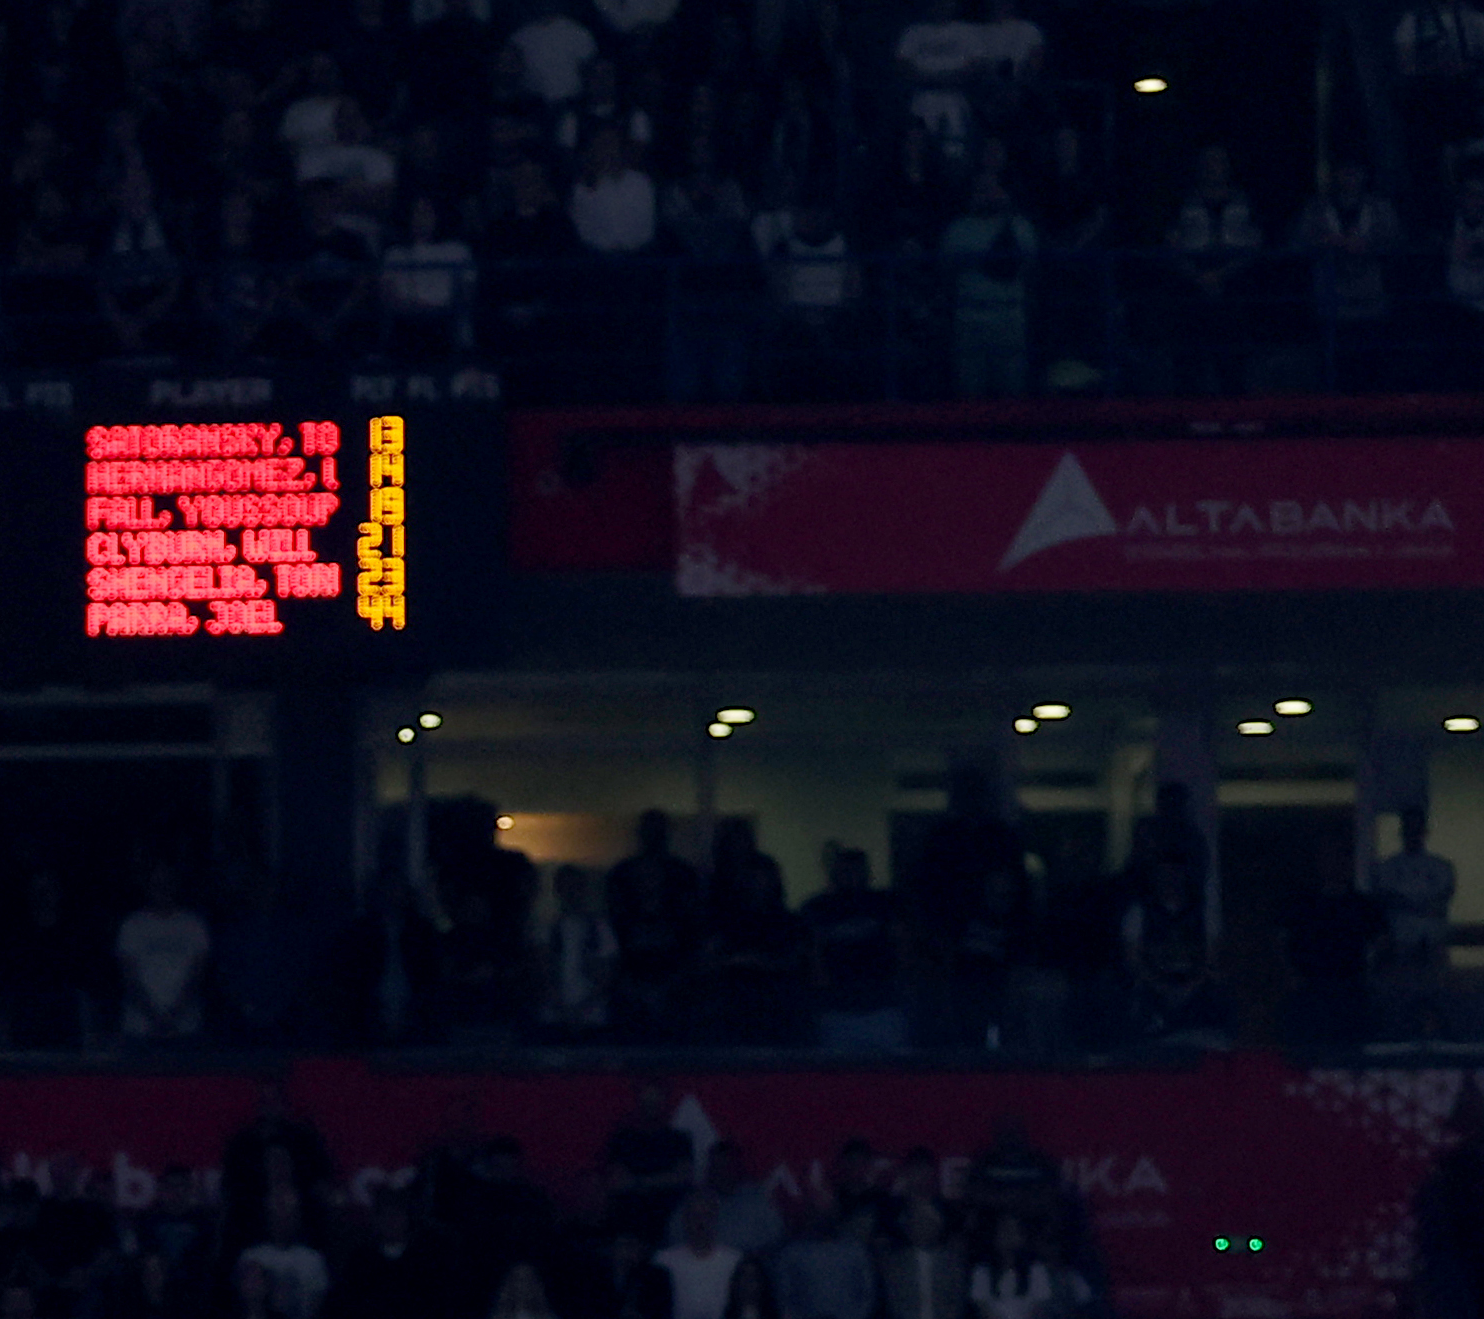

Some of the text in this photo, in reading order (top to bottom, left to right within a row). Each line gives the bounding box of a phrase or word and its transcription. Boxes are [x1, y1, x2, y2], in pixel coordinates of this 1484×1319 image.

[86, 424, 293, 459] SATORANSKY,
[370, 416, 404, 453] 13
[370, 453, 404, 488] 14
[86, 496, 172, 530] FALL,
[357, 522, 404, 559] 21
[357, 594, 405, 631] 44
